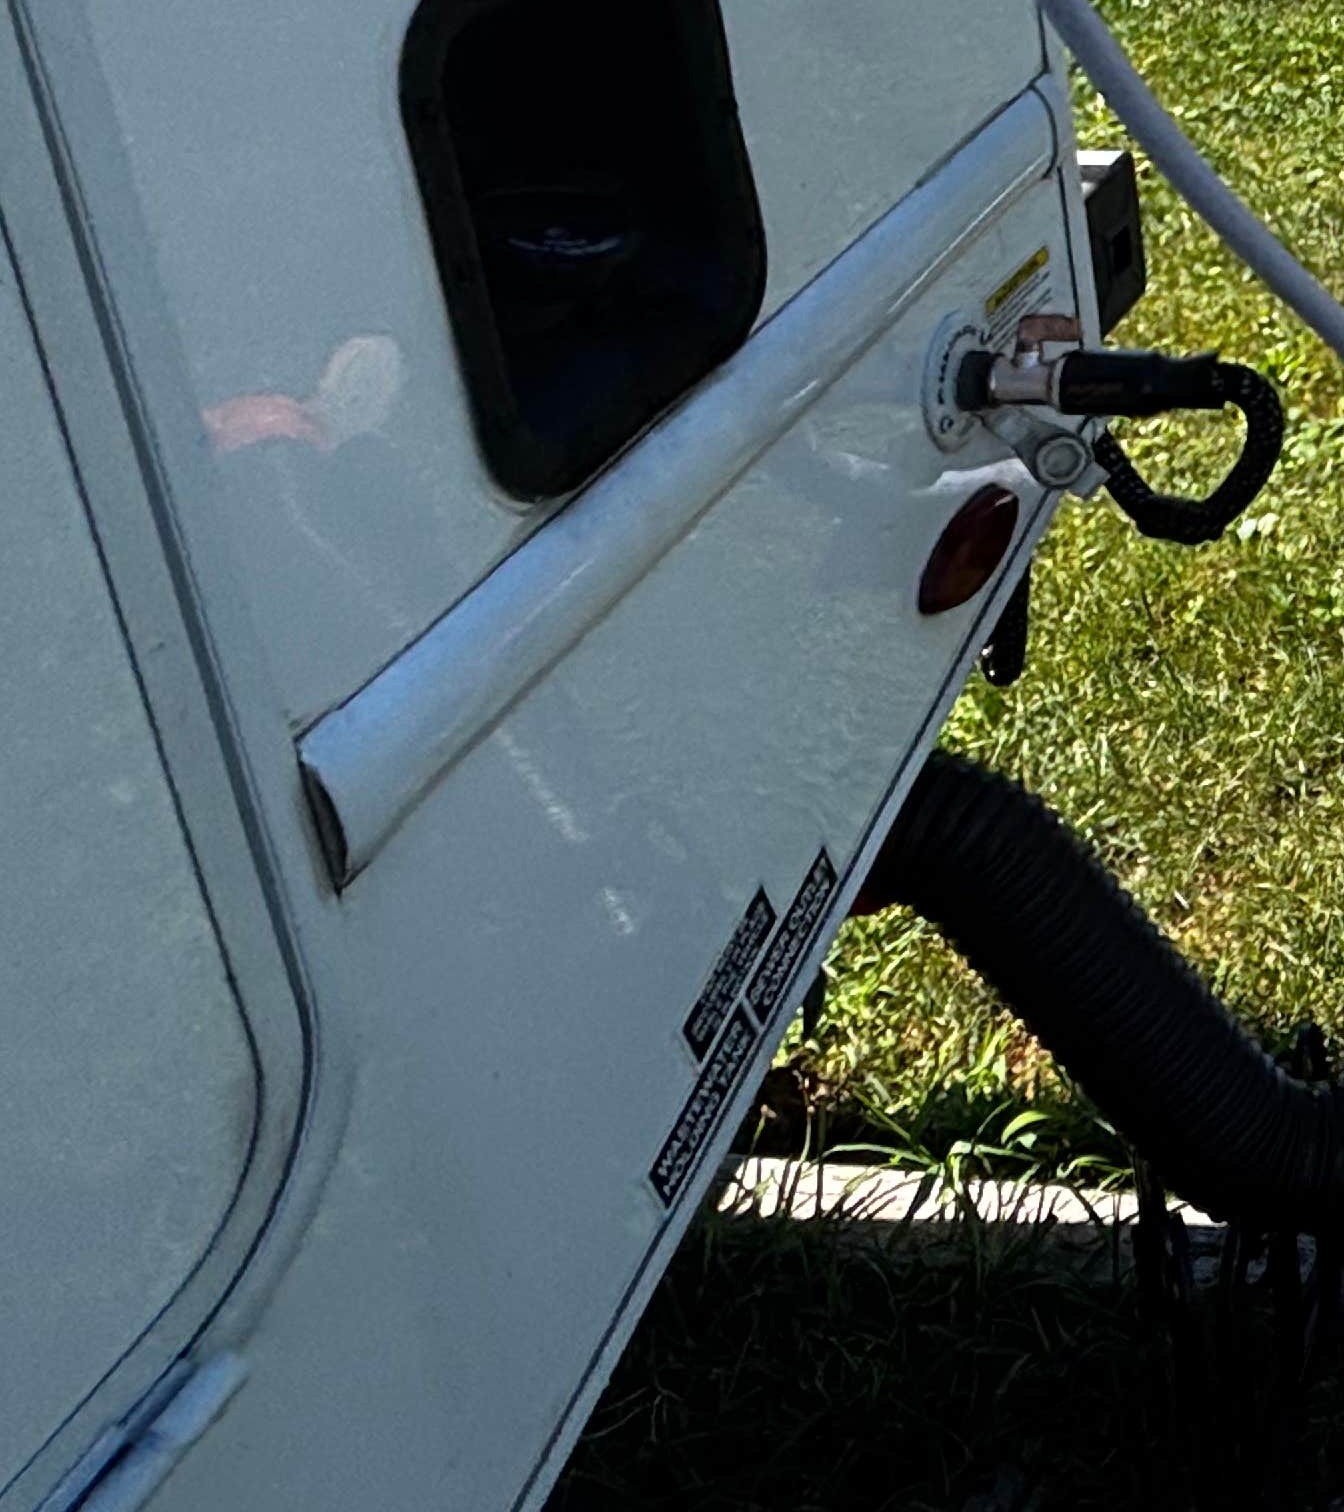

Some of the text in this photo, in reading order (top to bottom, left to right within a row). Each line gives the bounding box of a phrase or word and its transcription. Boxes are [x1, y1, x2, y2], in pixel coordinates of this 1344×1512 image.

[749, 928, 791, 1005] SEWER
[661, 1090, 721, 1196] HOLDING
[719, 1029, 752, 1086] TANK
